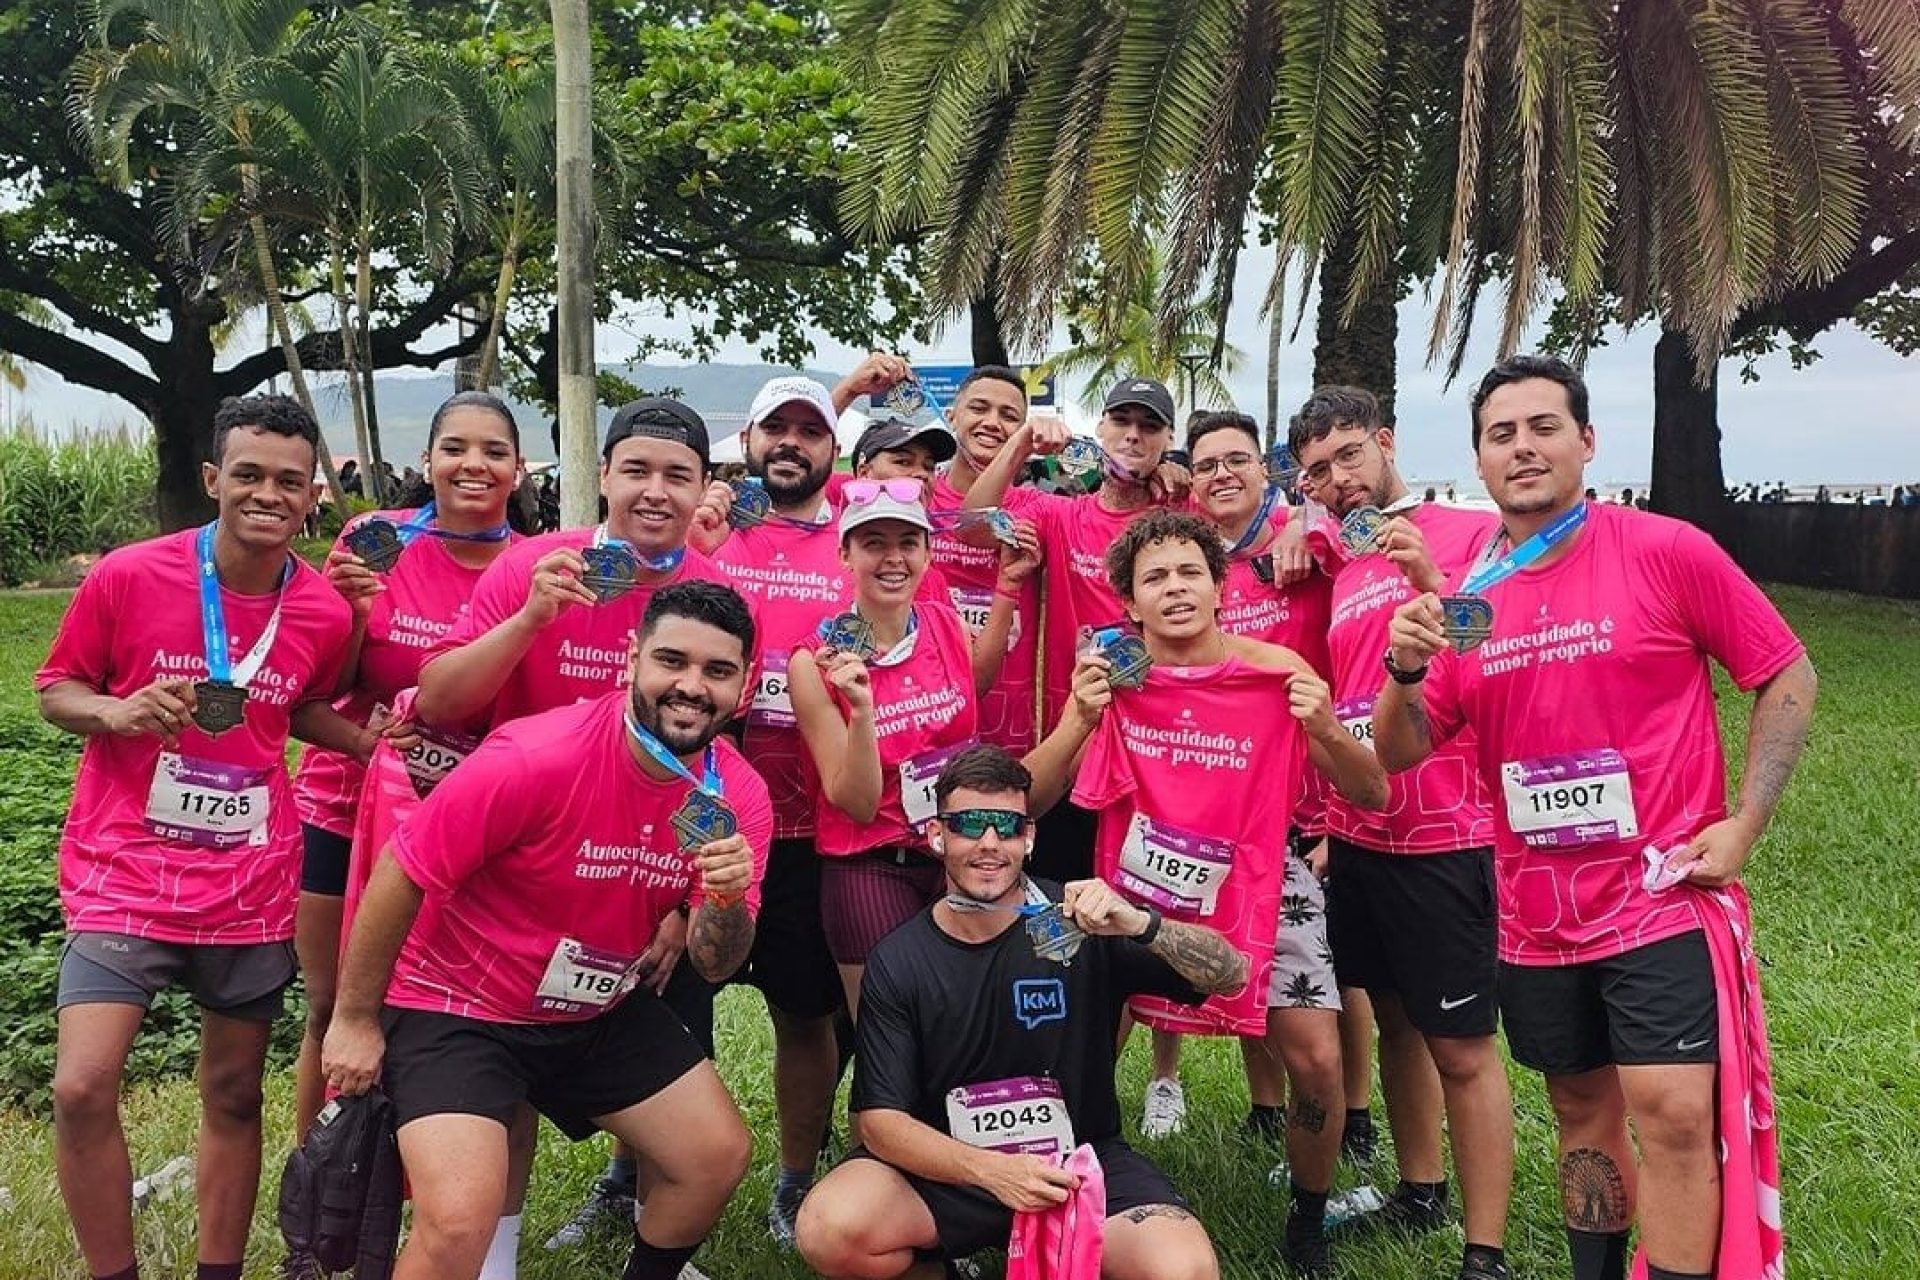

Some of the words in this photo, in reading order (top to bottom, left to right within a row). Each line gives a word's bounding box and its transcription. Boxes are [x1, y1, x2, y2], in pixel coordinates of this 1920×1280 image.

[389, 628, 433, 648] amo
[1479, 618, 1595, 659] Autocuidado
[558, 639, 627, 664] Autocu
[1482, 651, 1533, 677] amor
[560, 662, 613, 680] amor
[874, 717, 909, 738] mor
[407, 743, 459, 773] 902
[1171, 747, 1248, 771] próprio
[180, 792, 251, 817] 11765
[1530, 783, 1605, 813] 11907
[575, 862, 628, 879] amor
[1145, 849, 1211, 885] 11875
[1023, 991, 1057, 1009] KM
[970, 1103, 1053, 1134] 12043
